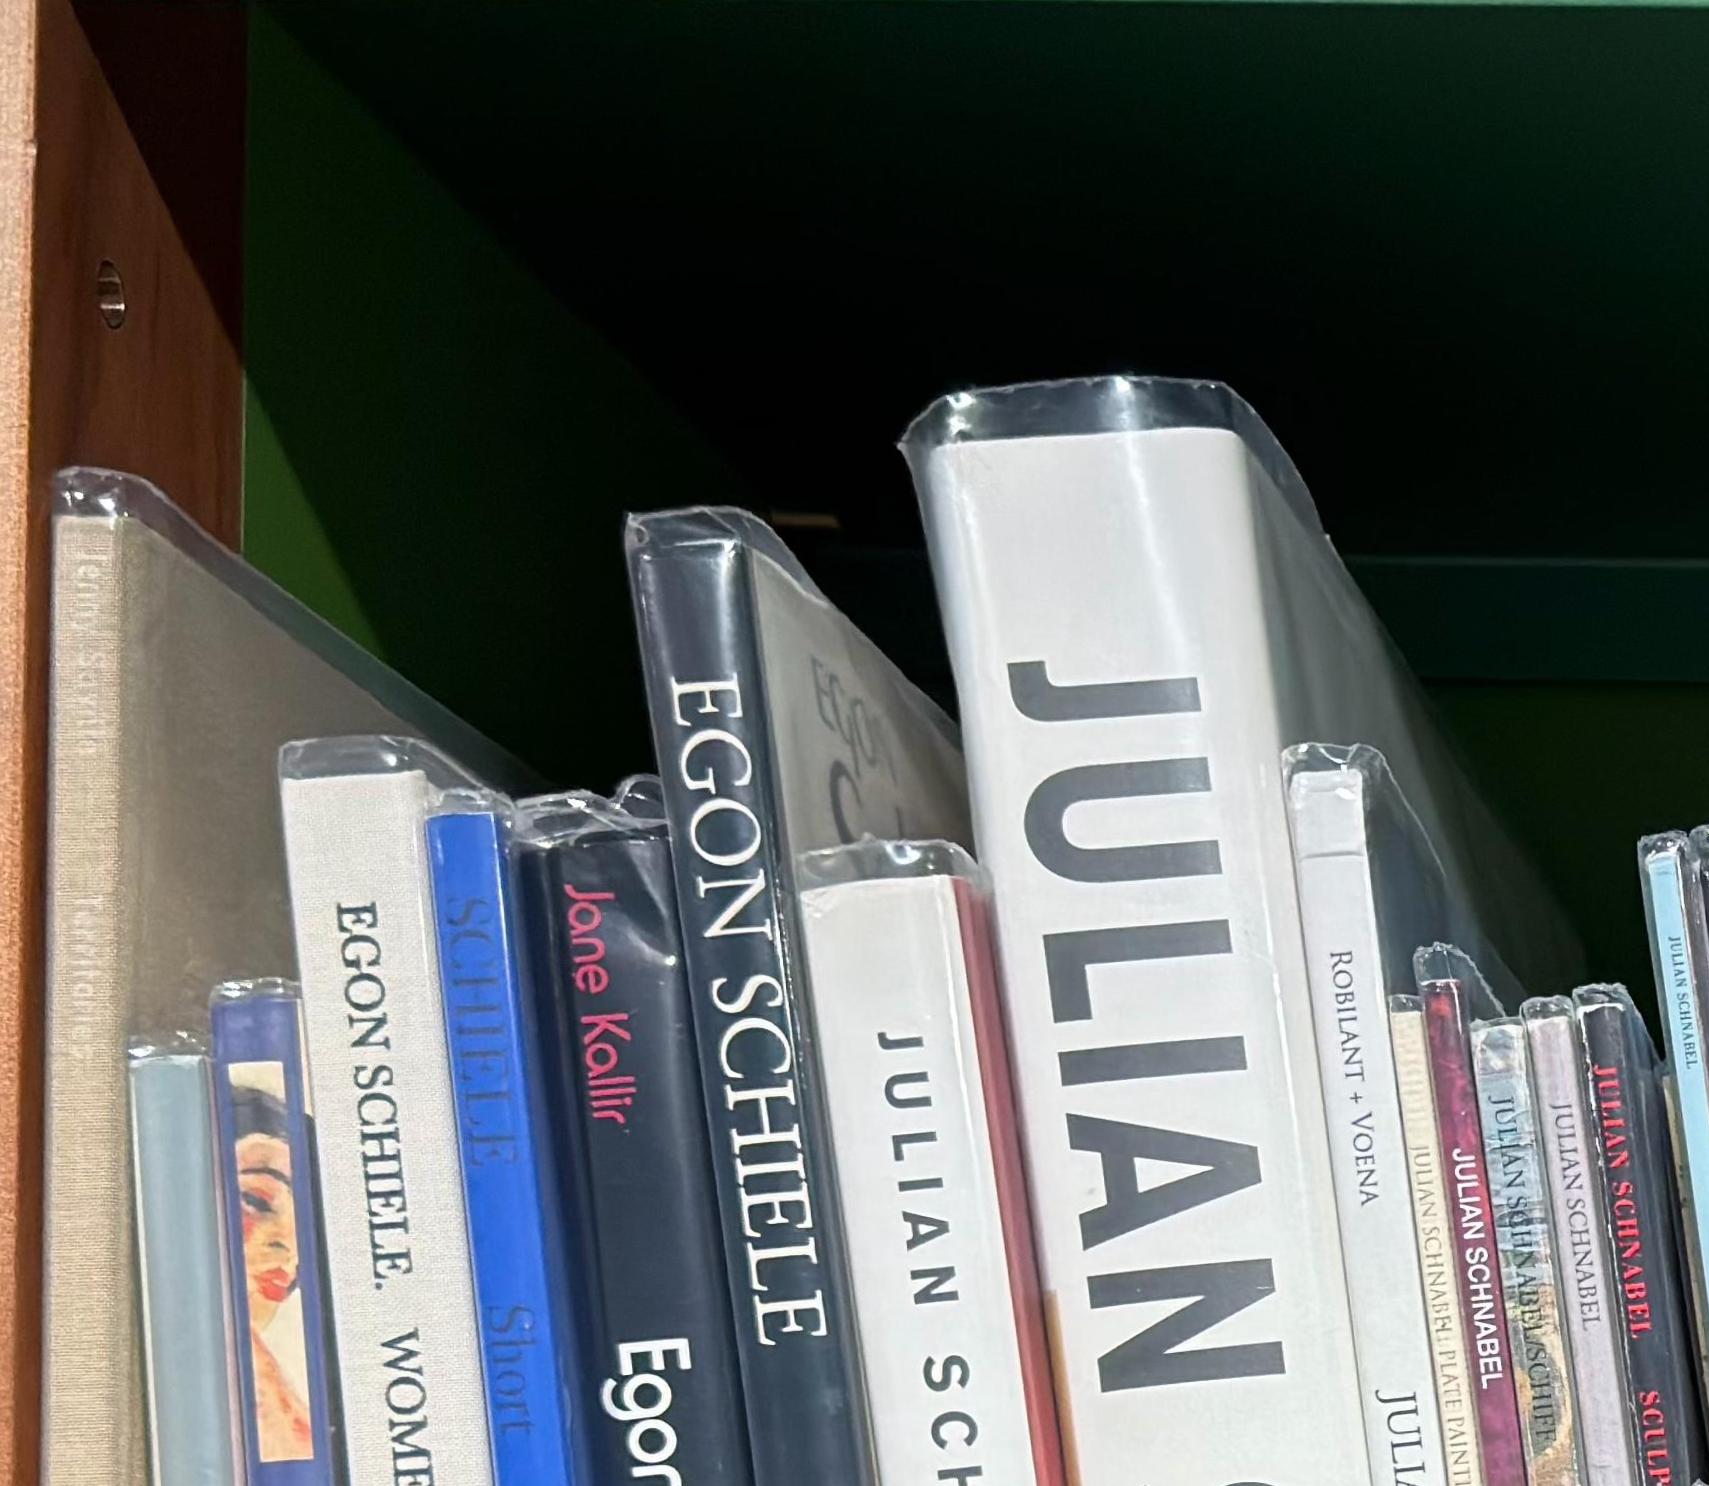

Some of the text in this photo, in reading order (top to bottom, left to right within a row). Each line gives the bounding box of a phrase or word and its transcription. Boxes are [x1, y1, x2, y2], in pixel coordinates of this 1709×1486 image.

[336, 901, 390, 1049] EGON
[565, 880, 636, 1123] Jane Kallir
[671, 675, 825, 1345] EGON SCHIELE
[1007, 660, 1285, 1392] JULIAN
[1330, 950, 1378, 1205] ROBILANT VOENA
[1668, 936, 1697, 1068] JULIAN SCHNABEL
[353, 1065, 412, 1289] SCHIELE.
[446, 898, 537, 1441] SCHIELE Short
[877, 1032, 958, 1304] JULIAN
[1452, 1148, 1502, 1388] JULIAN SCHNABEL
[1549, 1104, 1600, 1330] JULIAN SCHNABEL
[1589, 1062, 1629, 1171] JULIAN
[1613, 1181, 1651, 1338] SCHNABEL
